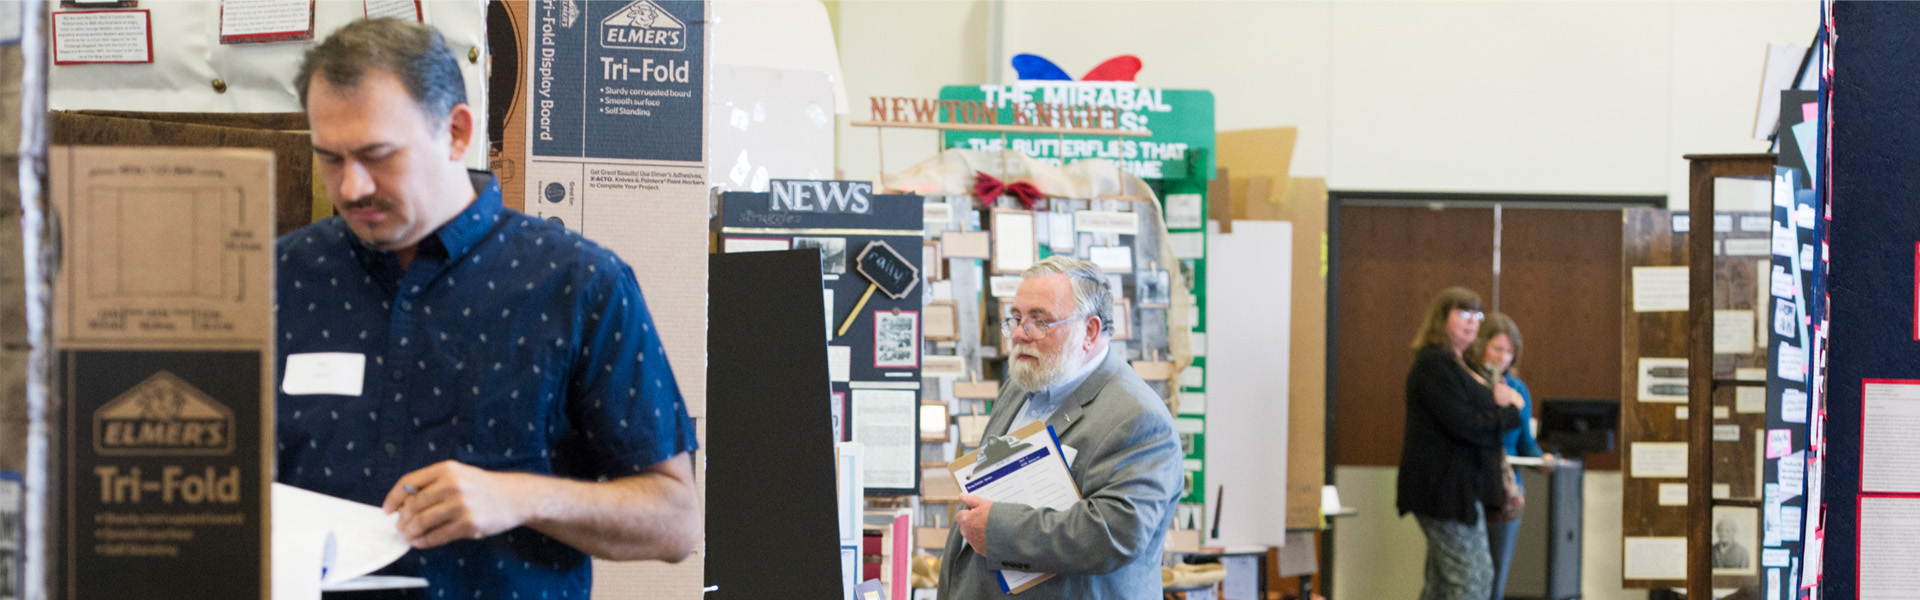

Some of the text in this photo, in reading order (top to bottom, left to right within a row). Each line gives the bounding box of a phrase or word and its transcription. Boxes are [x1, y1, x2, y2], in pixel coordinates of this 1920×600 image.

[607, 28, 680, 46] ELMER'S
[539, 0, 556, 141] ri-Fold Display Board
[600, 56, 689, 83] Tri-Fold
[605, 86, 692, 98] Sturdy corrugated board
[605, 96, 660, 107] Smooth surface
[979, 84, 1172, 112] THE MIRABAL
[605, 106, 651, 117] Self Standing
[869, 97, 1124, 130] NEWTON KNIGHT
[1012, 138, 1138, 159] BUTTERFLIES
[1139, 141, 1188, 161] THAT
[771, 181, 872, 214] NEWS
[94, 465, 241, 504] Tri-Fold
